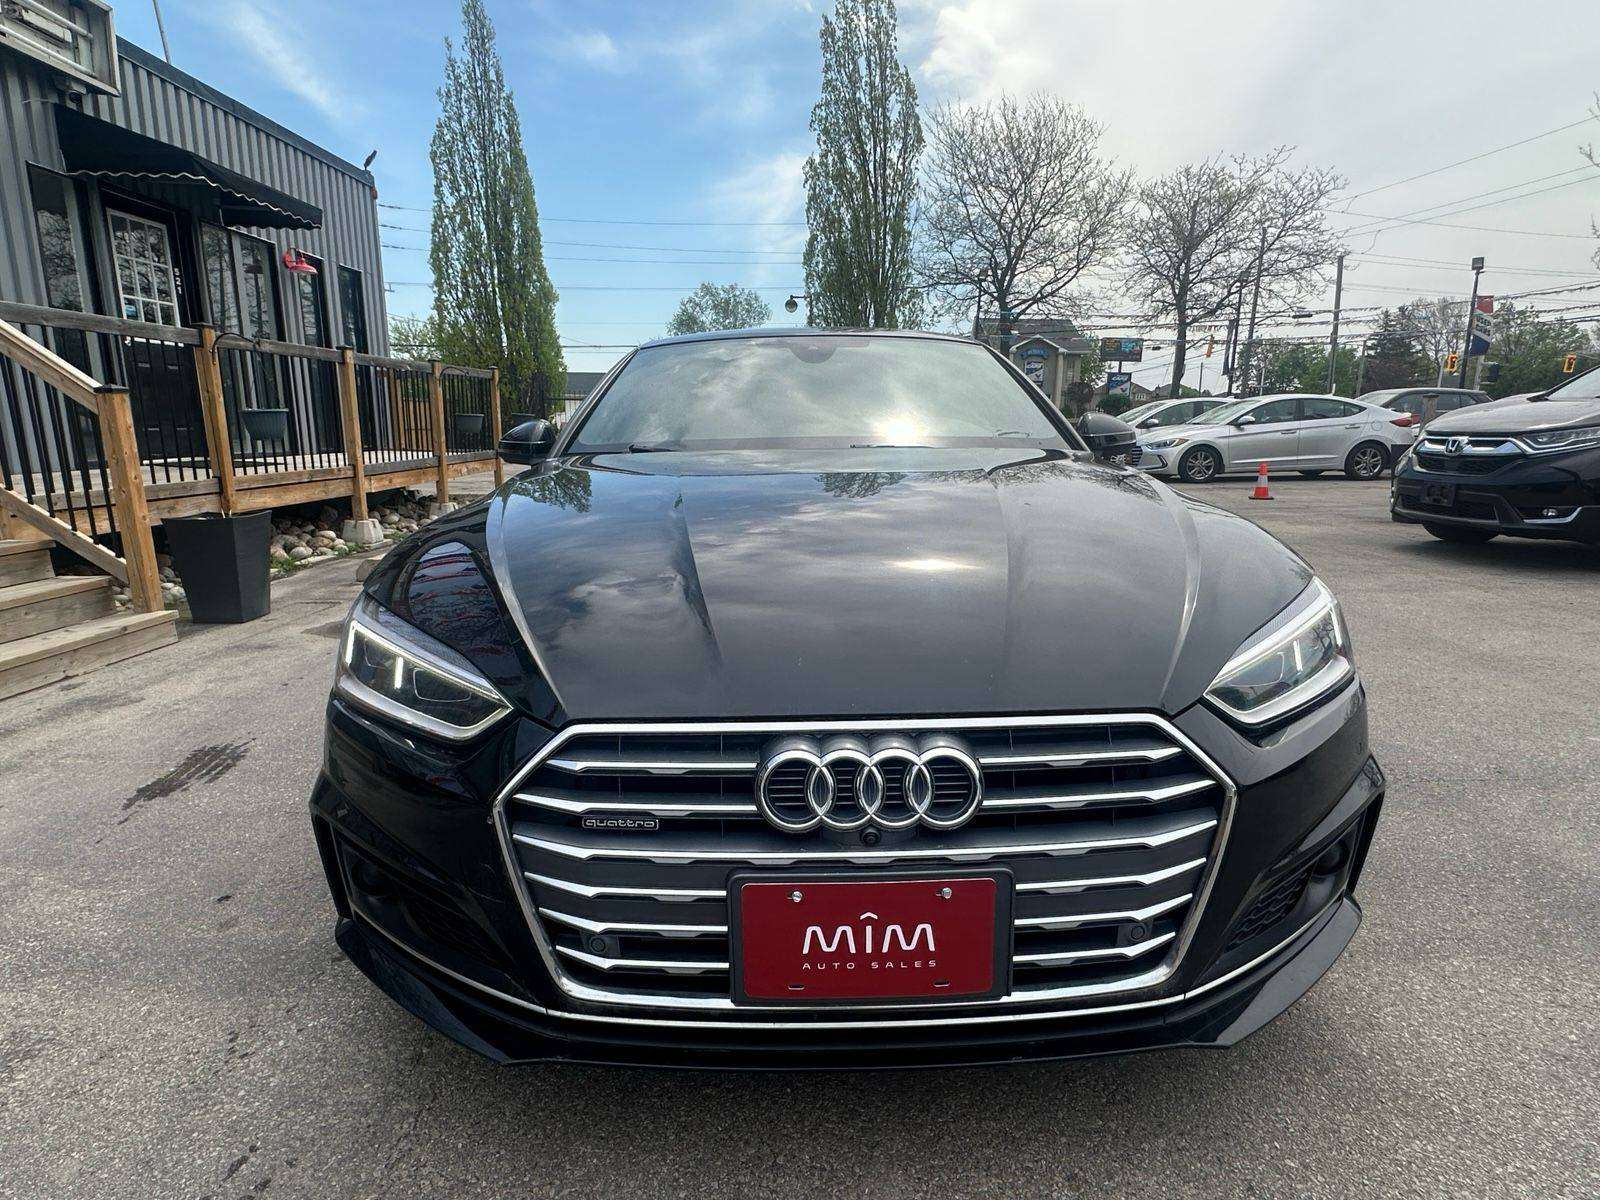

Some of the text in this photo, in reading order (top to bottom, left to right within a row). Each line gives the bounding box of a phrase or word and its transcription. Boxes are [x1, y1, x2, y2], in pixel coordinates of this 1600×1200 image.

[585, 819, 655, 828] quattro
[802, 960, 937, 970] AUTO SALES
